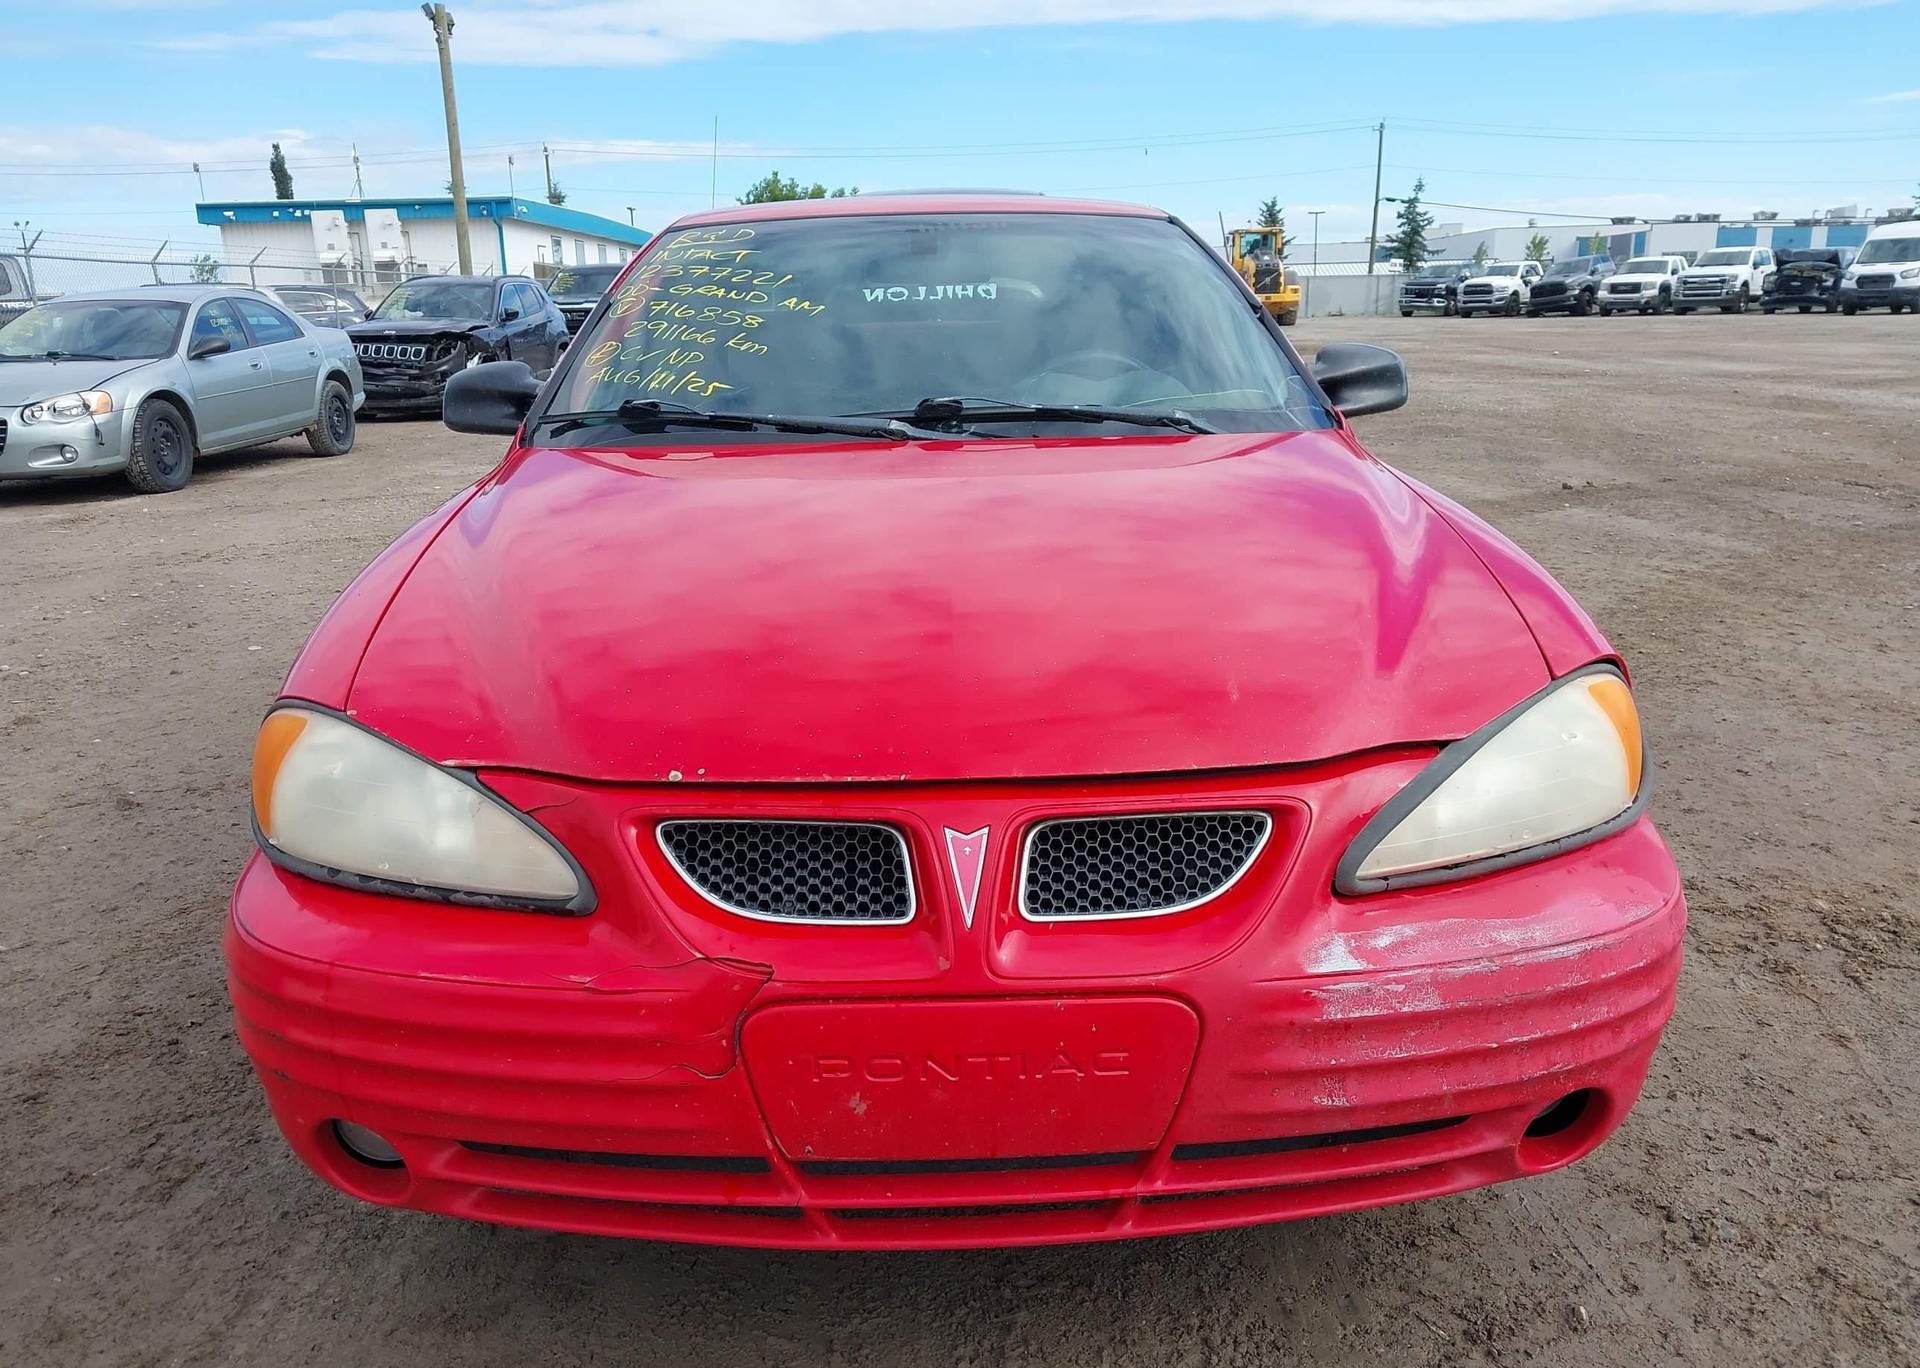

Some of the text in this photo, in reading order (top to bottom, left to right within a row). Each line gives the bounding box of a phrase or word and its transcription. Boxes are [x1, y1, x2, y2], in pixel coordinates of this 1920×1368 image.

[651, 249, 761, 263] INTACT
[631, 265, 793, 288] 12377221
[669, 284, 768, 303] GRAND
[778, 297, 826, 317] AM
[624, 320, 716, 344] 291166
[811, 1052, 1131, 1084] PONTIAC
